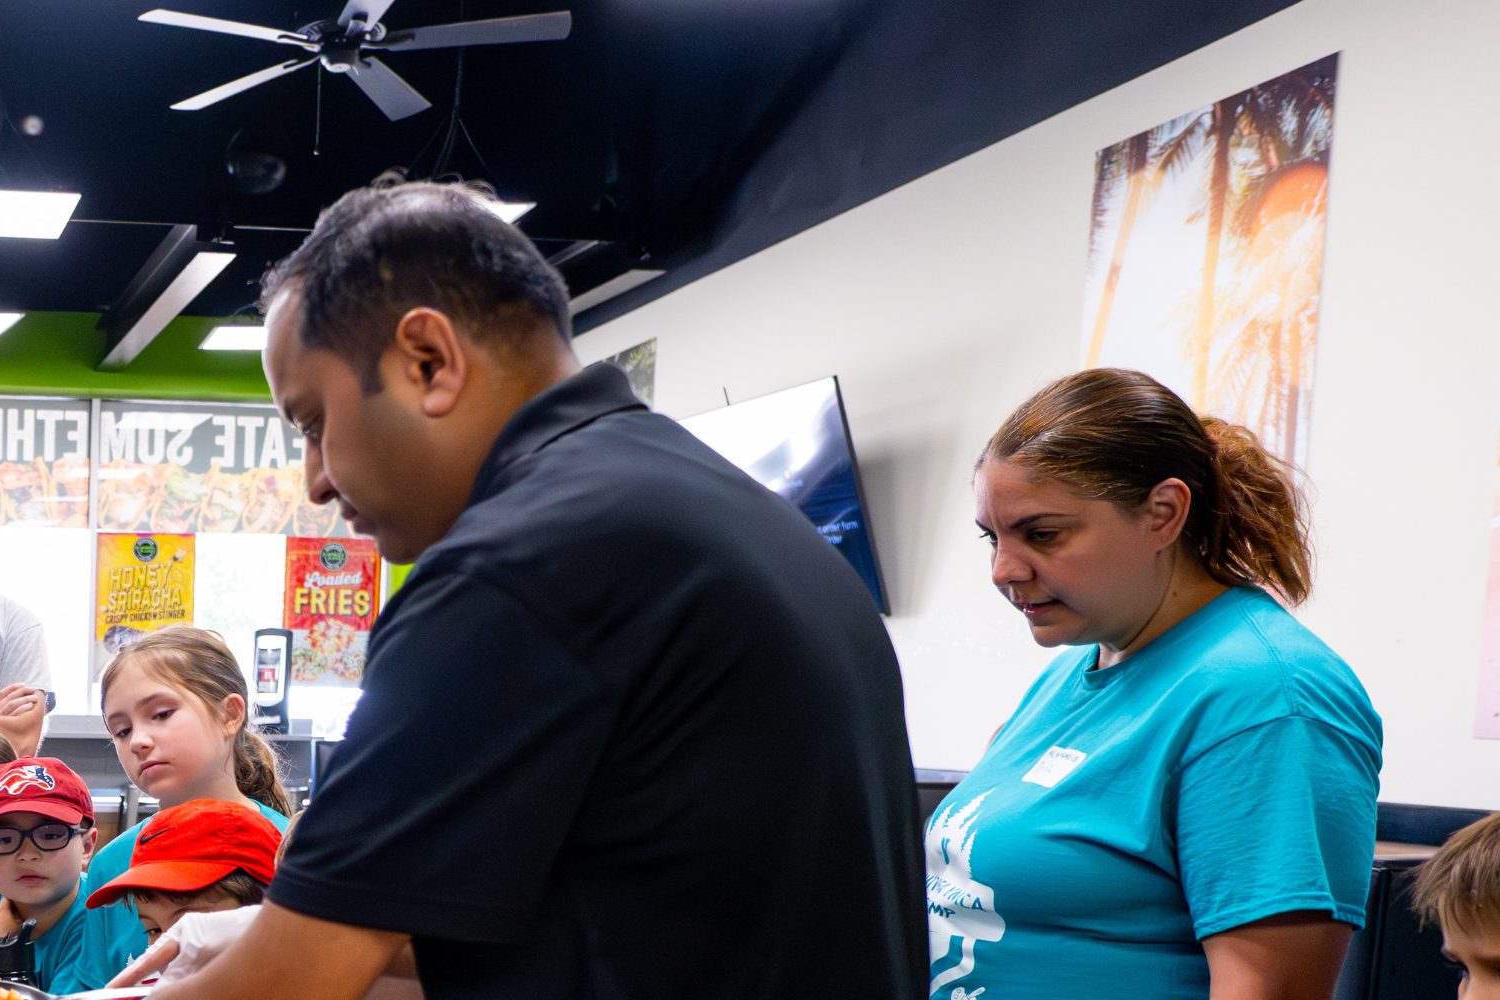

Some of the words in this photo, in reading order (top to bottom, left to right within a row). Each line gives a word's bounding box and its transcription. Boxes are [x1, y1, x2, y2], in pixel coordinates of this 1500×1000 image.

[108, 563, 172, 592] HONEY
[303, 571, 363, 590] Loaded
[108, 588, 182, 611] SRIRACHA
[295, 586, 370, 617] FRIES
[105, 613, 128, 624] CRISPY
[129, 611, 157, 622] CHICKEN
[159, 609, 185, 619] STINGER
[928, 902, 956, 918] MP
